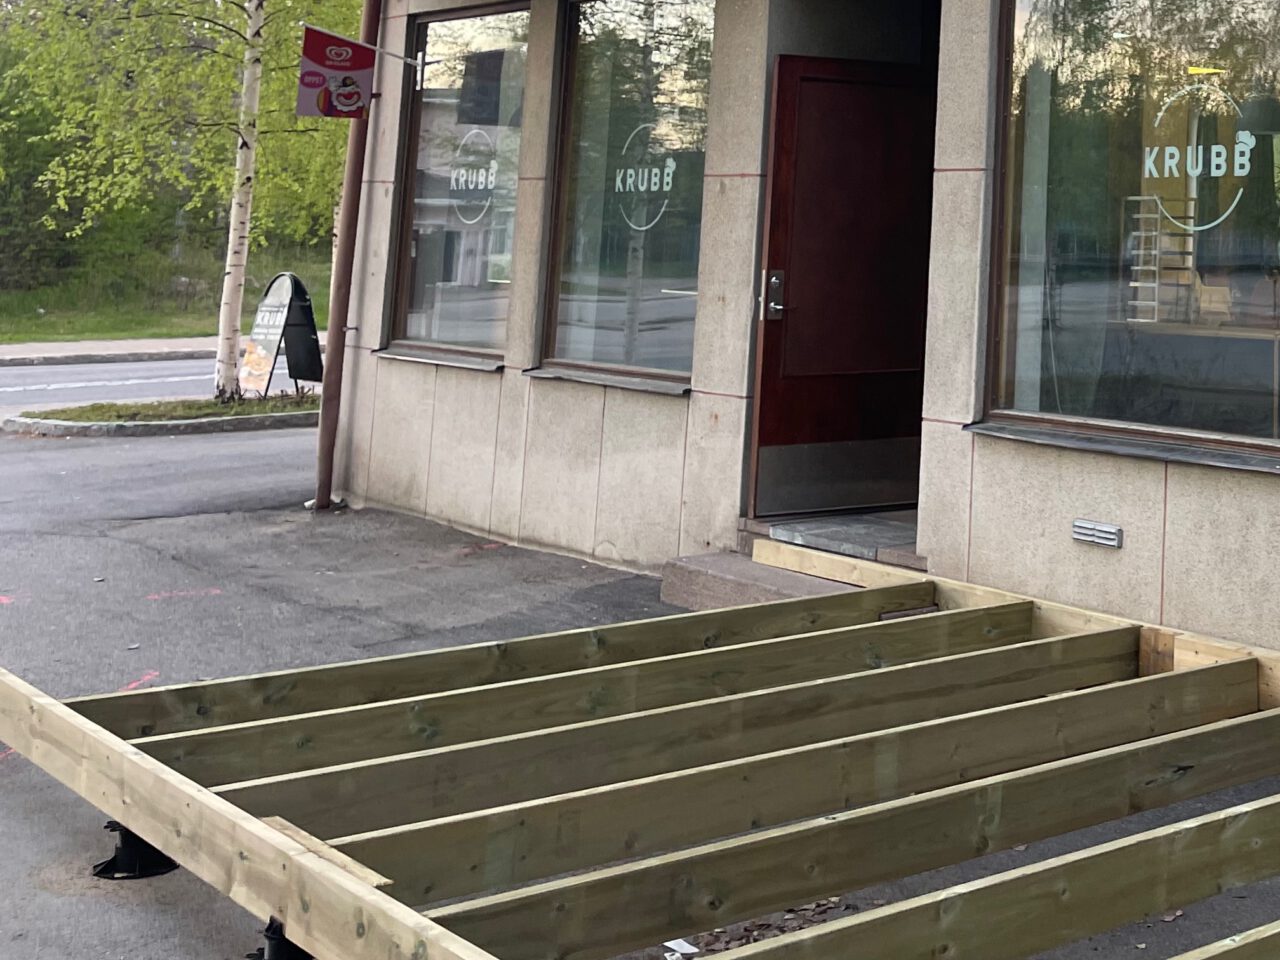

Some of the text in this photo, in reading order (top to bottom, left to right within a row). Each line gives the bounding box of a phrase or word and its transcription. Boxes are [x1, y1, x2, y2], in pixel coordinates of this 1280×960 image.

[1144, 143, 1251, 178] KRUBB
[450, 167, 496, 190] KRUBB
[614, 166, 673, 192] KRUBB
